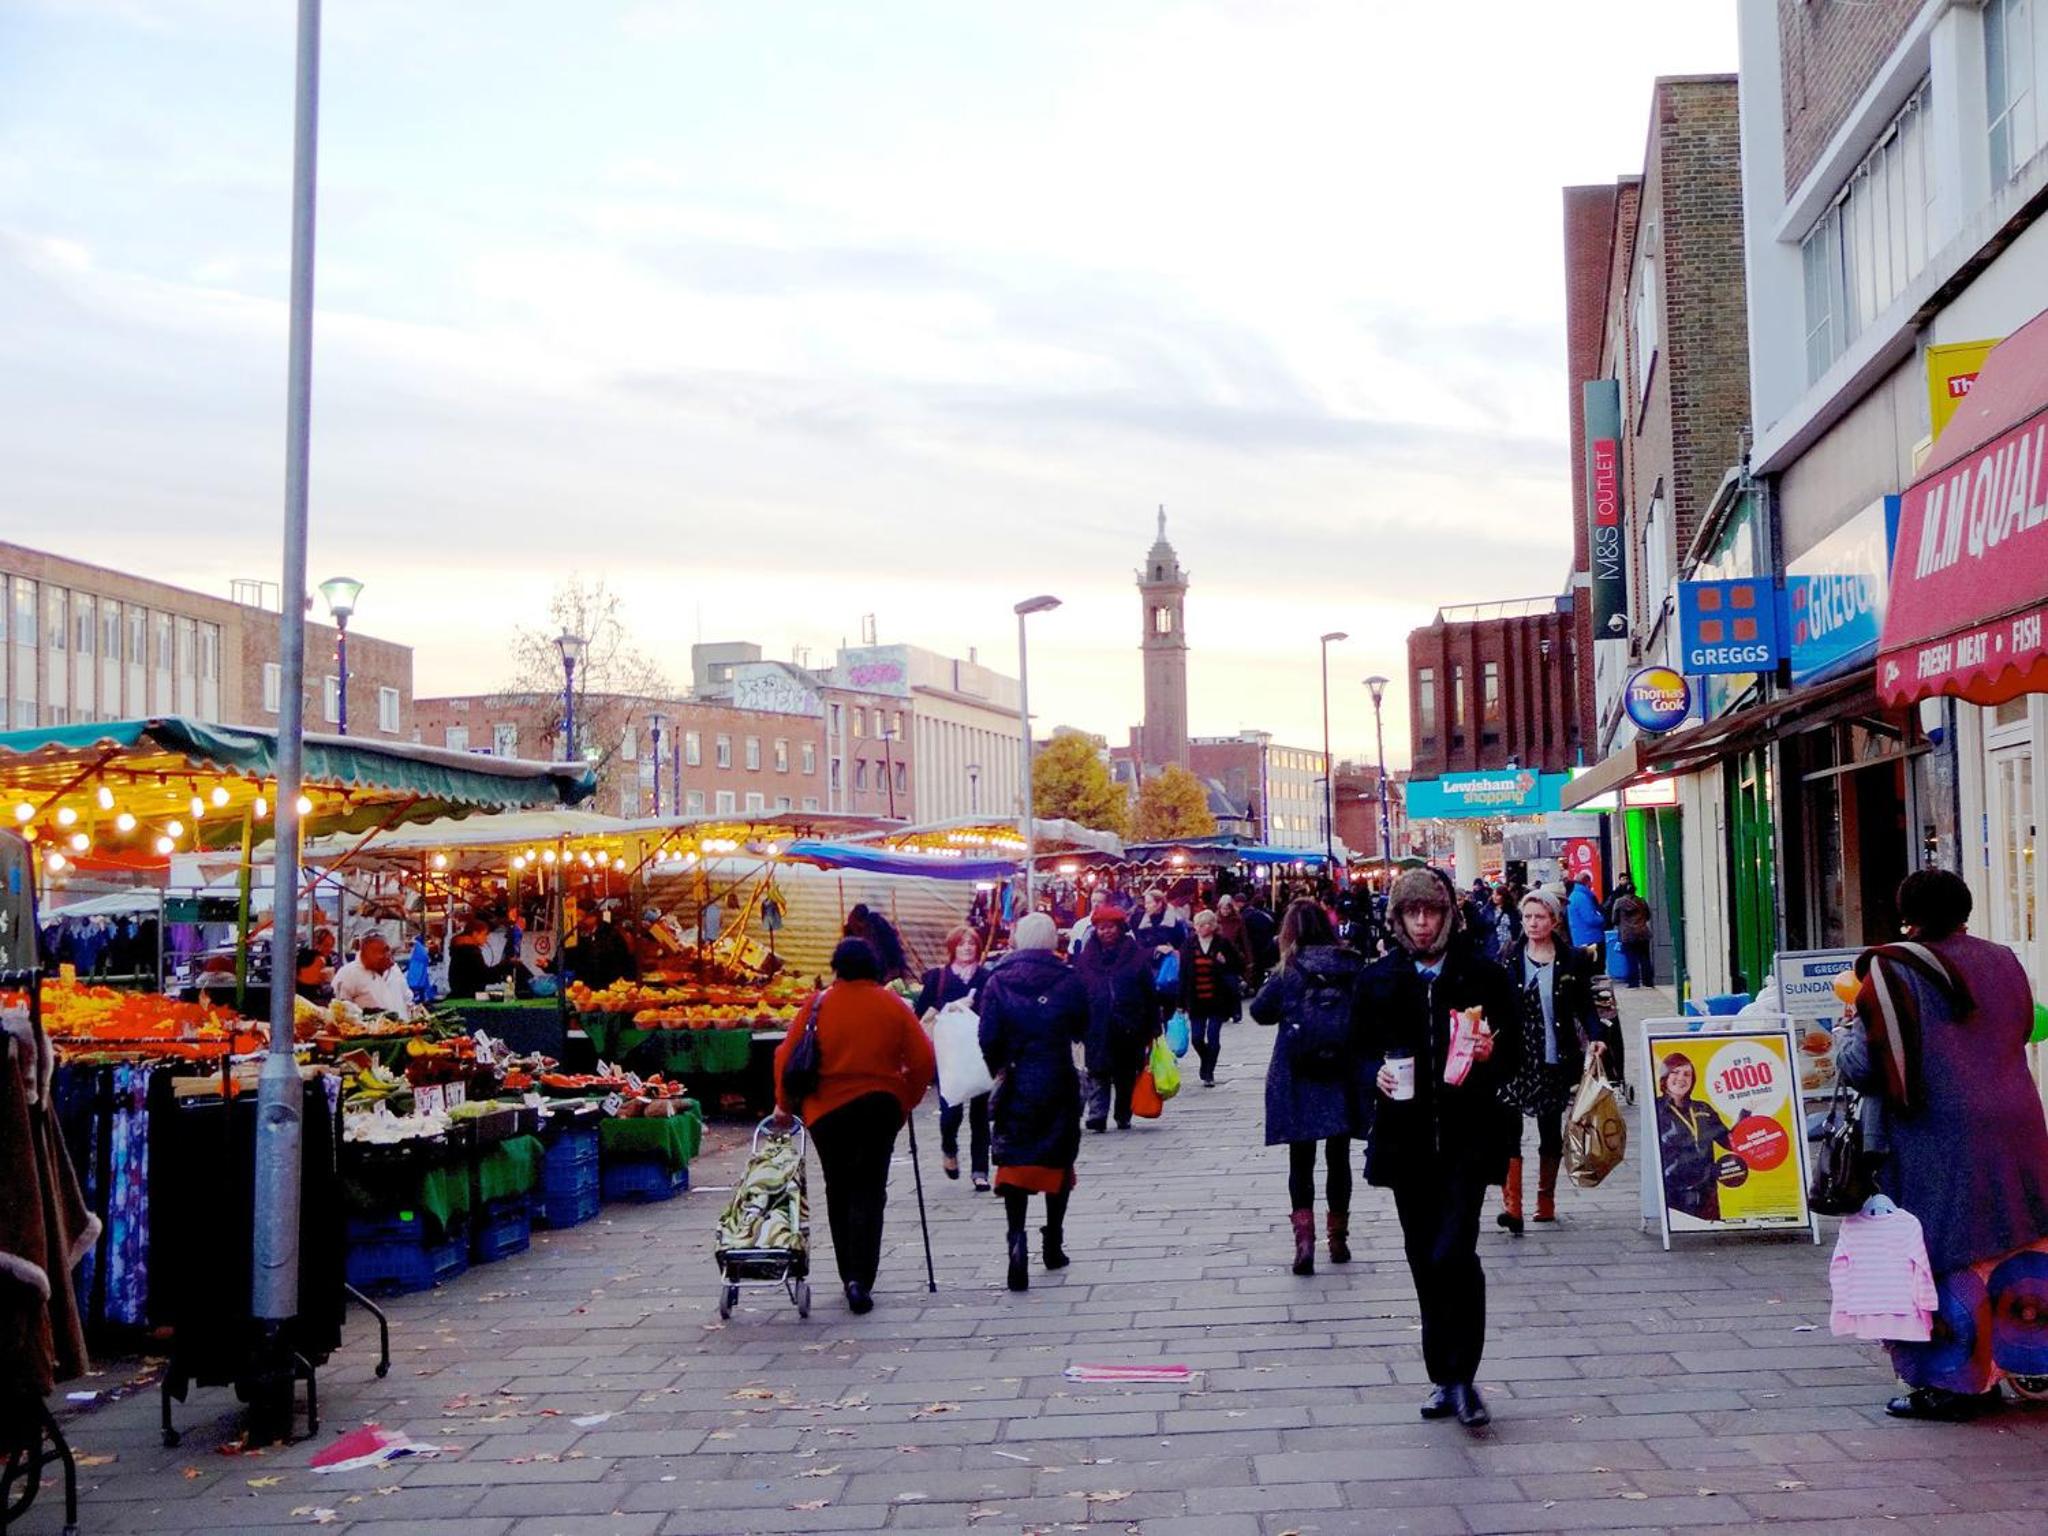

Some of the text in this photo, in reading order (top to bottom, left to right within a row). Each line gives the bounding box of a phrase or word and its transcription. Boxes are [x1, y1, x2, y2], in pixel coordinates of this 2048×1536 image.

[1950, 377, 1974, 394] Th
[1967, 423, 2048, 560] QUAL
[1595, 451, 1621, 580] M&S OUTLET
[1917, 614, 2041, 679] FRESH MEAT FISH
[1691, 645, 1769, 666] GREGGS
[1631, 687, 1685, 702] Thomas
[1652, 698, 1685, 712] Cook
[1443, 778, 1515, 793] Lewisham
[1463, 791, 1524, 805] shopping
[1814, 963, 1851, 974] GREGGS
